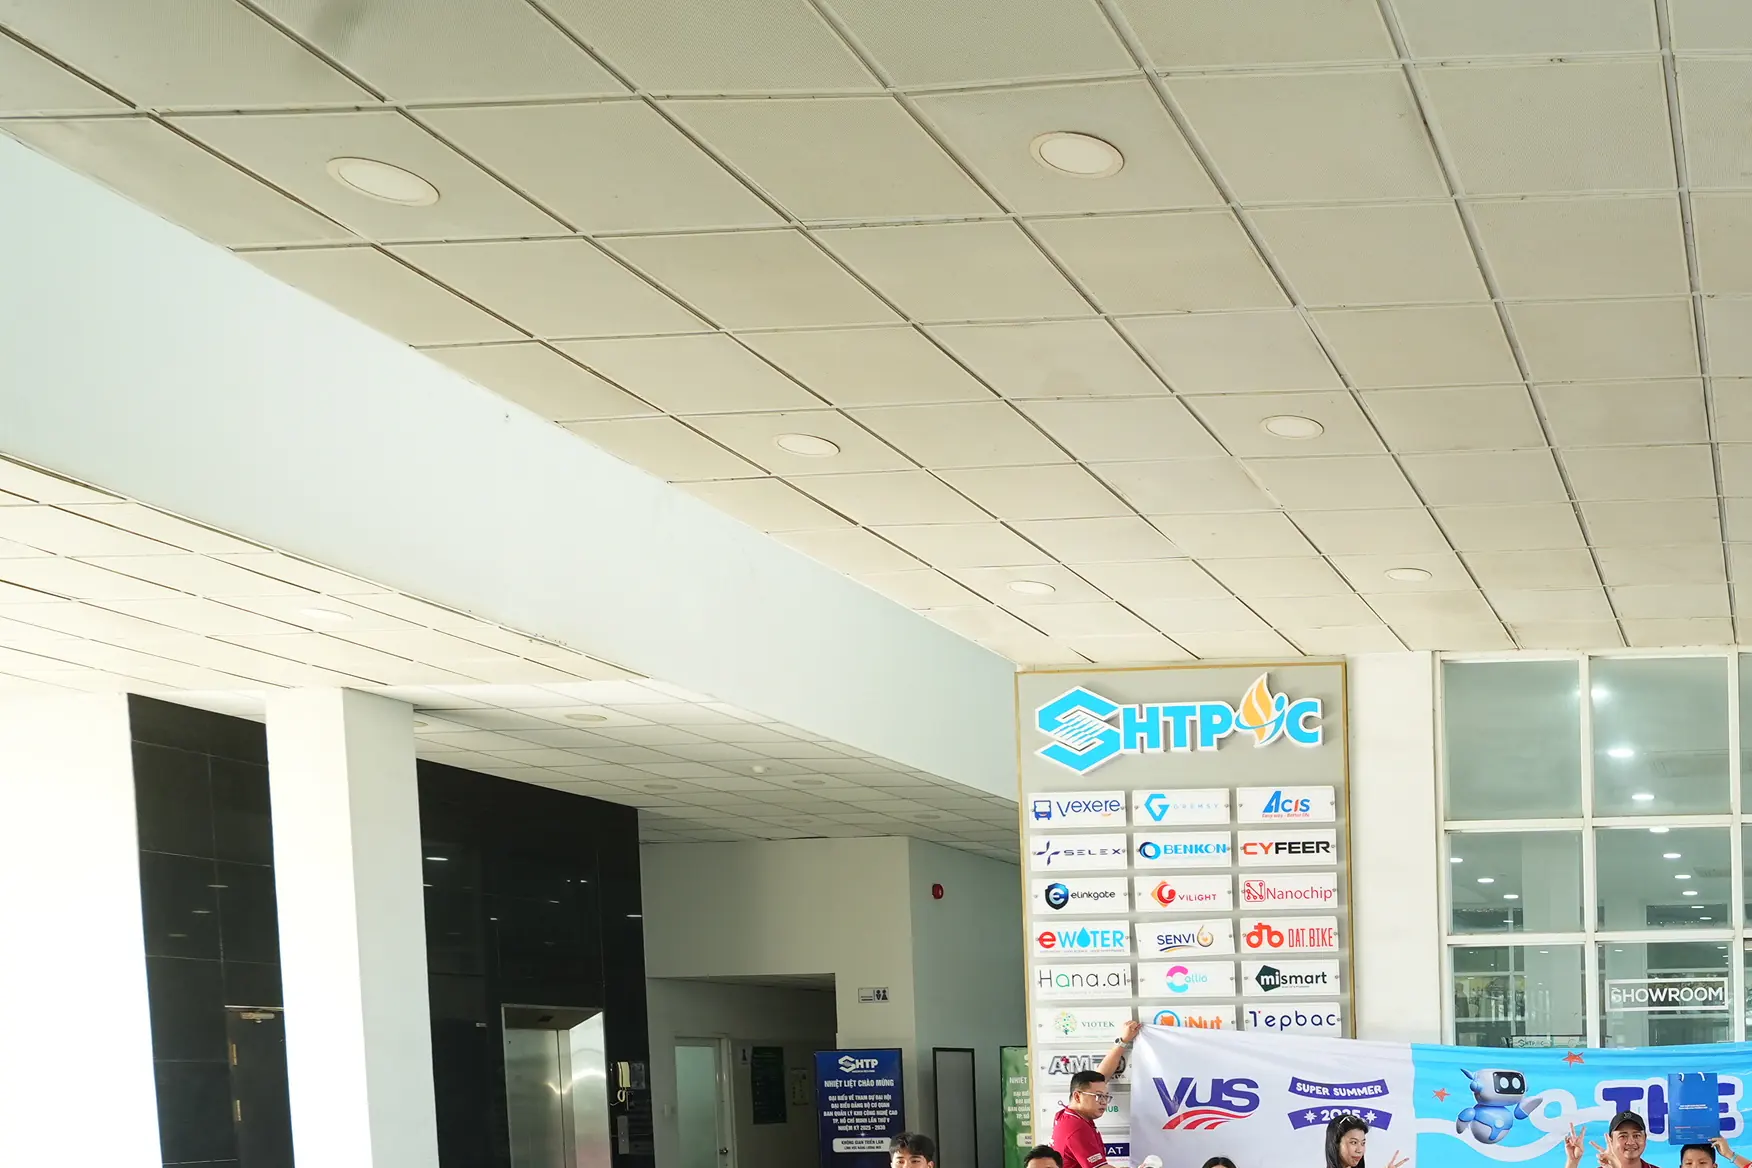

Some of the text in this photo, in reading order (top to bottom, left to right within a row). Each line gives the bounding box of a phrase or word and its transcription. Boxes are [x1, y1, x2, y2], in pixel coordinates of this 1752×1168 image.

[1064, 848, 1121, 856] SELEX
[1163, 843, 1227, 855] BENKON
[1243, 841, 1331, 855] CYFEER
[1179, 893, 1216, 901] VILIGHT
[1266, 887, 1333, 902] Nanochip
[1288, 927, 1334, 949] DAT.BIKE
[1039, 969, 1128, 988] Hana.ai
[1260, 971, 1328, 987] mismart
[1610, 985, 1725, 1003] SHOWROOM
[1081, 1020, 1116, 1028] VIOTEK
[1249, 1009, 1336, 1031] Tepbac
[1295, 1081, 1383, 1097] SUPER SUMMER
[1152, 1077, 1261, 1119] VUS
[1320, 1107, 1361, 1122] 2025
